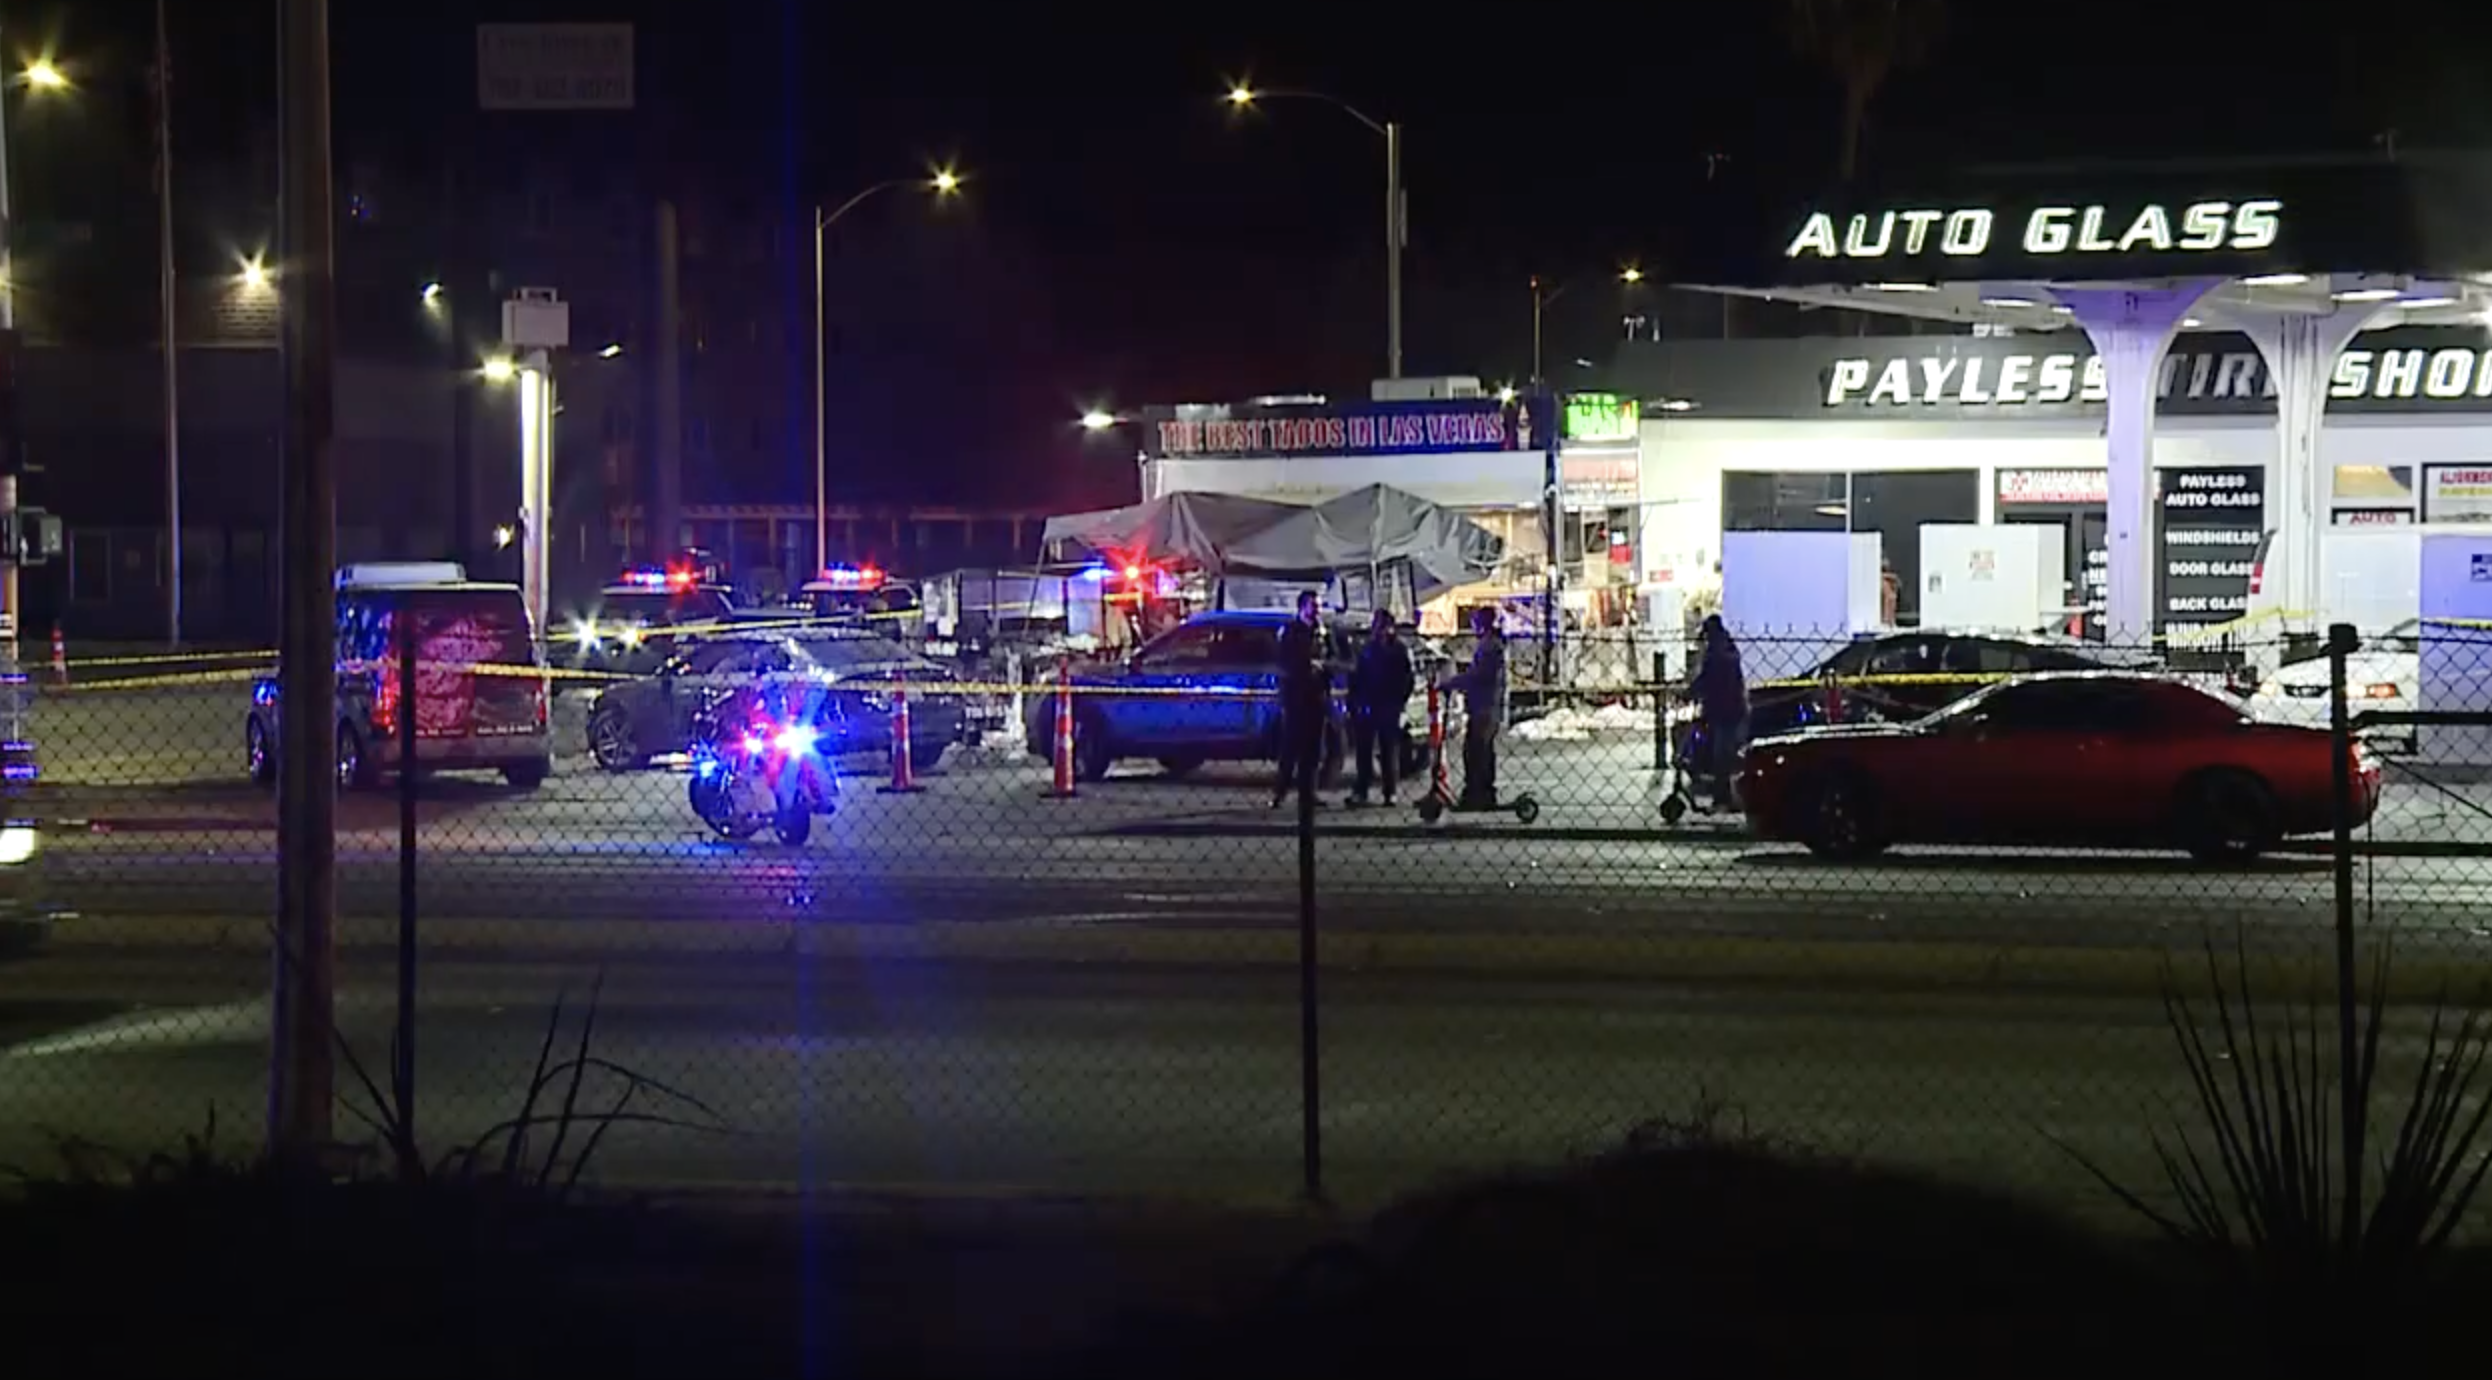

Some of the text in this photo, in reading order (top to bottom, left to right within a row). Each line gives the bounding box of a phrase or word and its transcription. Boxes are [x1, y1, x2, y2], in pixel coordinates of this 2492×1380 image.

[1786, 200, 2284, 258] AUTO GLASS
[1826, 354, 2109, 405] PAYLESS
[1158, 411, 1505, 452] THE BEST TACOS IN LAS VEGAS
[2180, 475, 2246, 488] PAYLESS
[2166, 491, 2261, 506] AUTO GLASS
[2166, 530, 2260, 545] WINDSHIELDS
[2169, 561, 2208, 576] DOOR
[2169, 597, 2207, 611] BACK
